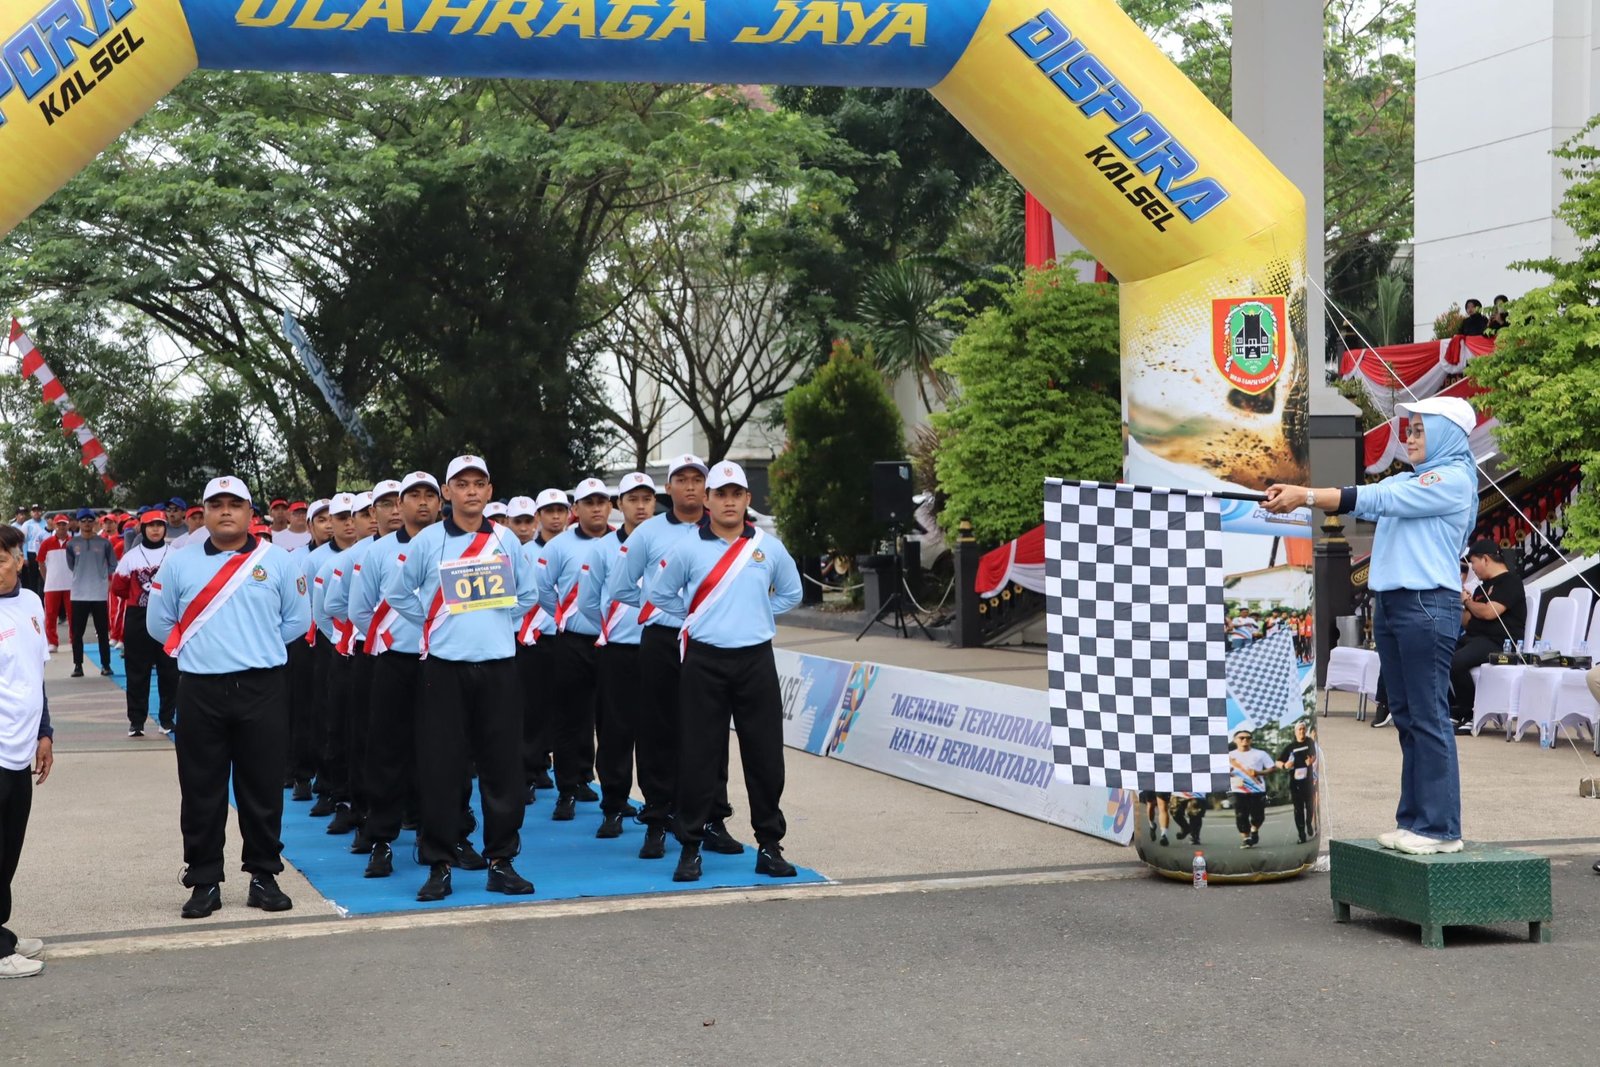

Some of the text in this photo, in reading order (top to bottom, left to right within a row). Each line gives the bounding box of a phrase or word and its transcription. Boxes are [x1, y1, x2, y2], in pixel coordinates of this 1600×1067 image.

[235, 0, 928, 47] OLAHRAGA JAYA
[39, 27, 145, 126] KALSEL
[1007, 9, 1229, 222] DISPORA
[1085, 145, 1175, 232] KALSEL
[455, 574, 505, 599] 012
[889, 727, 1055, 789] KALAH BERMARTABAT
[960, 706, 1053, 750] TERHORMA
